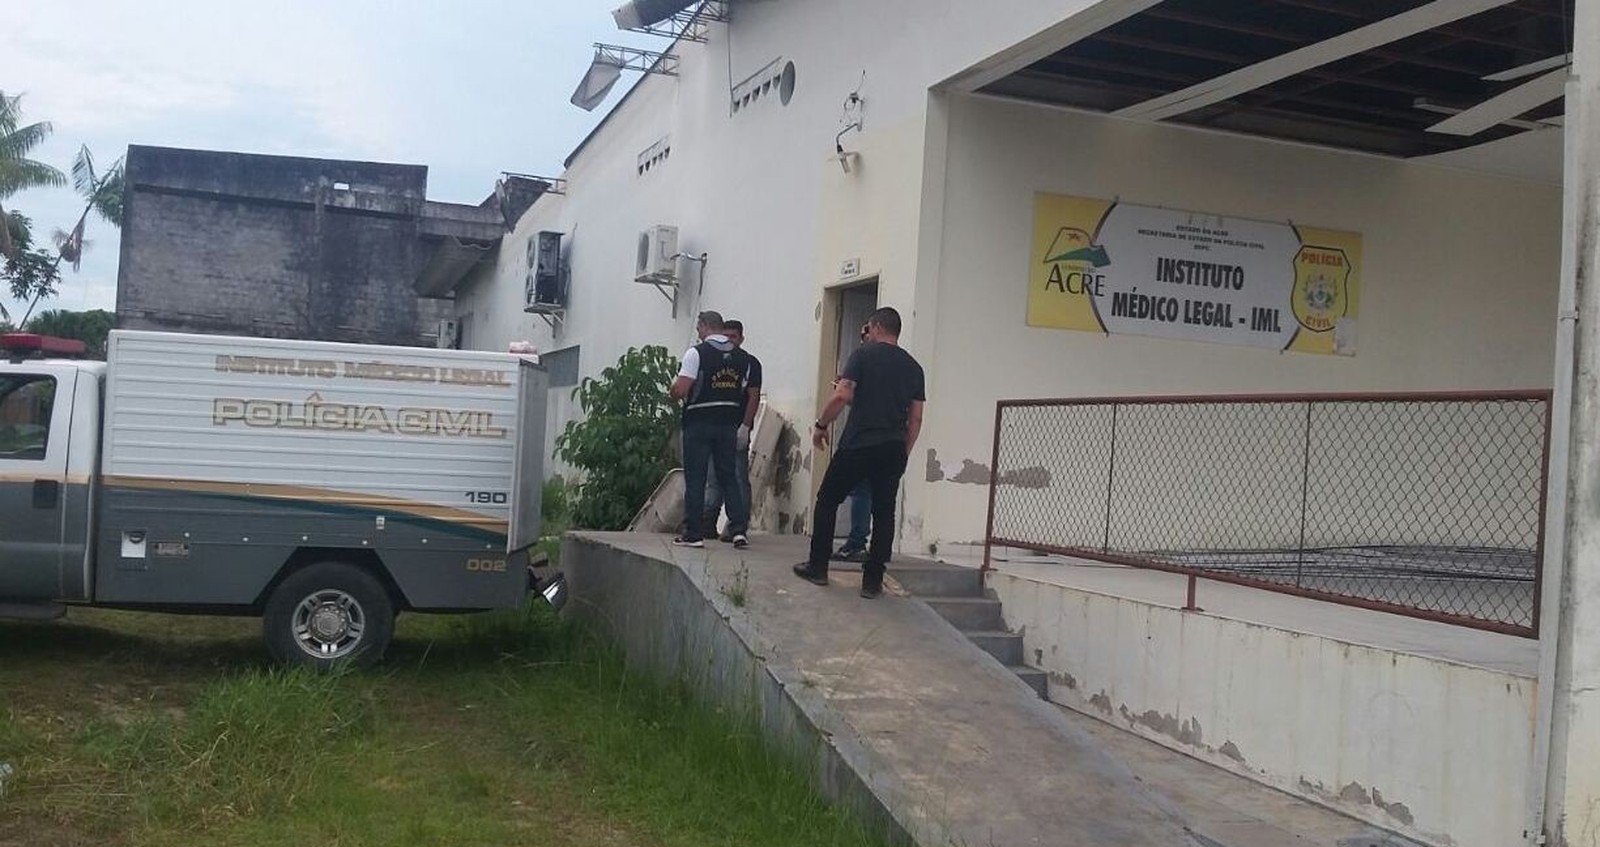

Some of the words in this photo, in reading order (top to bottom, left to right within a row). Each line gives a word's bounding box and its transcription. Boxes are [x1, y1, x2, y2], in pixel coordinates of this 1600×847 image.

[1045, 263, 1106, 297] ACRE
[1156, 257, 1245, 291] INSTITUTO
[1111, 286, 1179, 323] MÉDICO
[1183, 299, 1233, 328] LEGAL
[1251, 306, 1281, 333] IML
[1306, 315, 1331, 329] CIVIL
[215, 354, 337, 378] INSTITUTO
[397, 406, 508, 438] CIVIL
[465, 491, 507, 504] 190
[466, 559, 507, 572] 002
